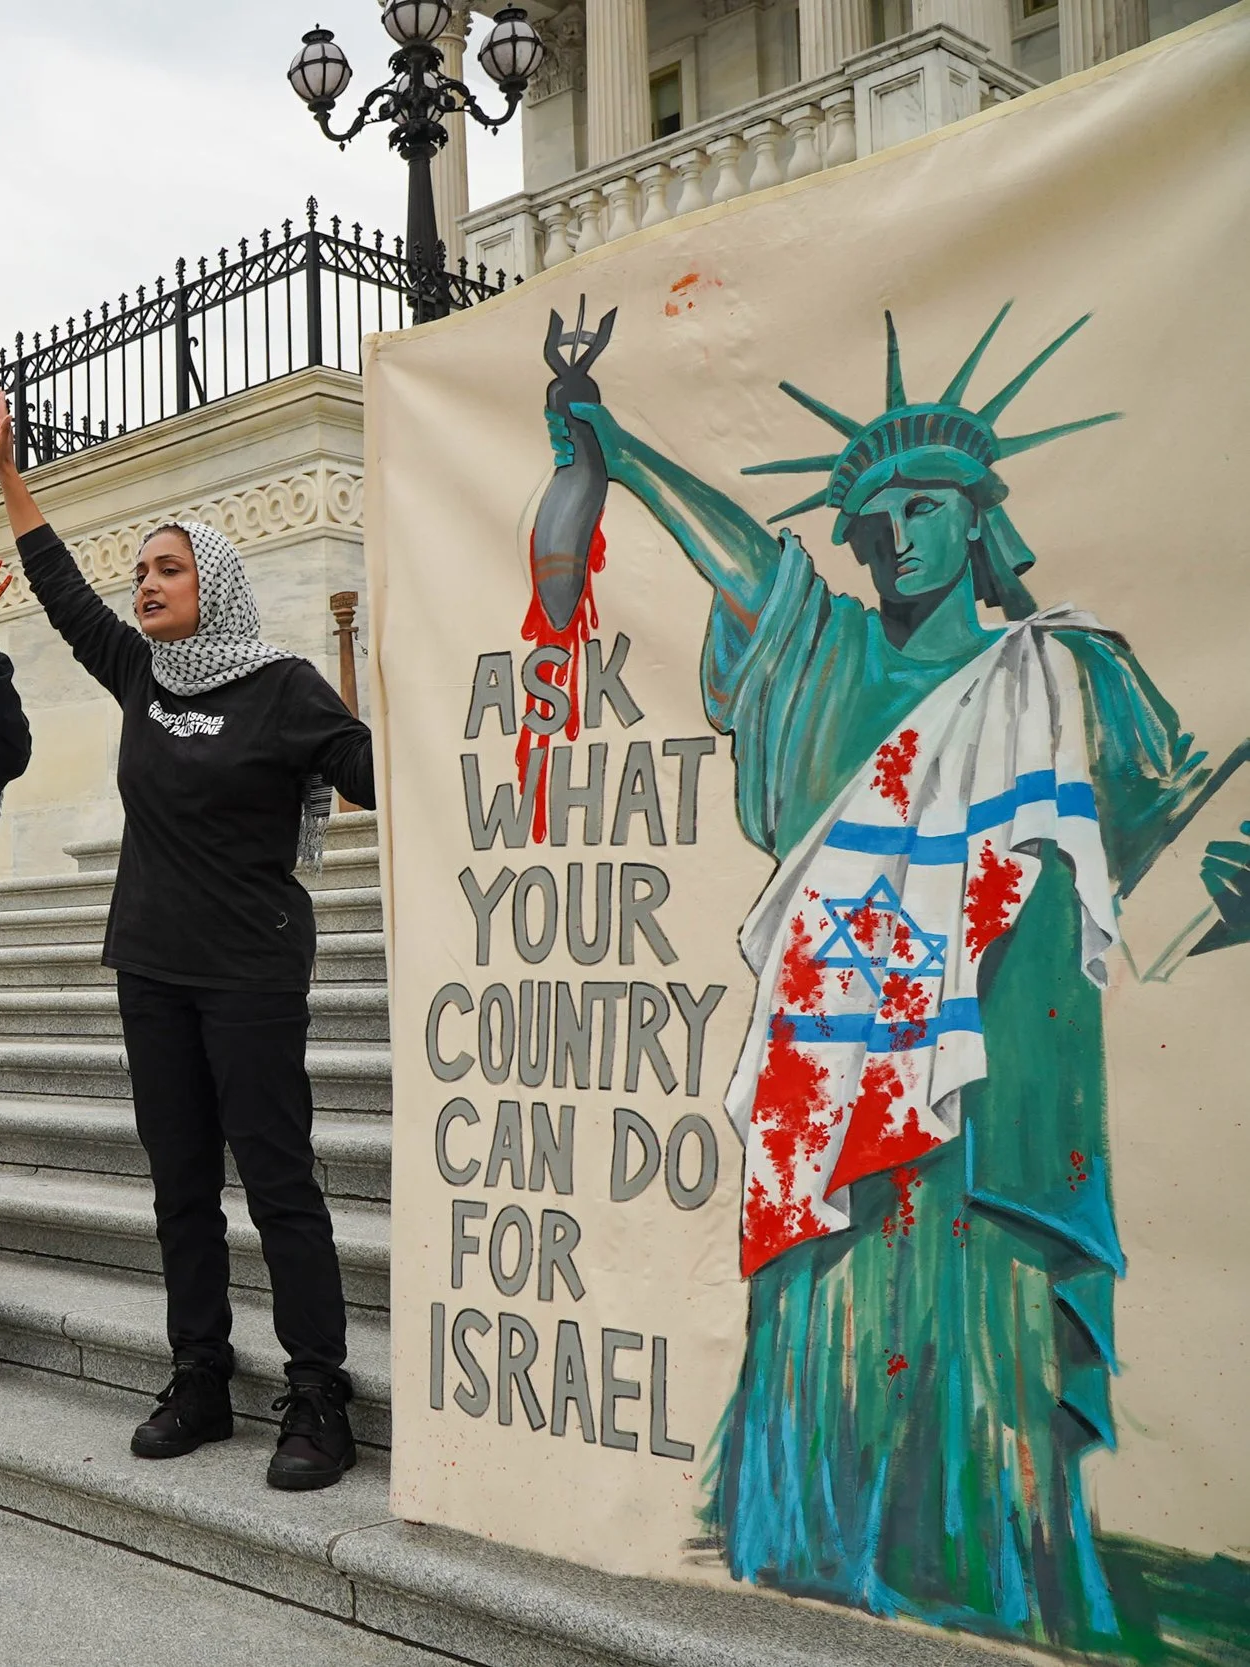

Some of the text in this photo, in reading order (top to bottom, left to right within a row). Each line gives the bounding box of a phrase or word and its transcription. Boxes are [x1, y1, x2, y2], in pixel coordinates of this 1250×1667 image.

[187, 711, 225, 725] ISRAEL
[464, 632, 645, 739] ASK
[460, 736, 716, 851] WHAT
[458, 862, 679, 966] YOUR
[425, 979, 728, 1097] COUNTRY
[435, 1096, 719, 1210] CAN DO
[451, 1199, 586, 1302] FOR
[430, 1302, 695, 1462] ISRAEL
